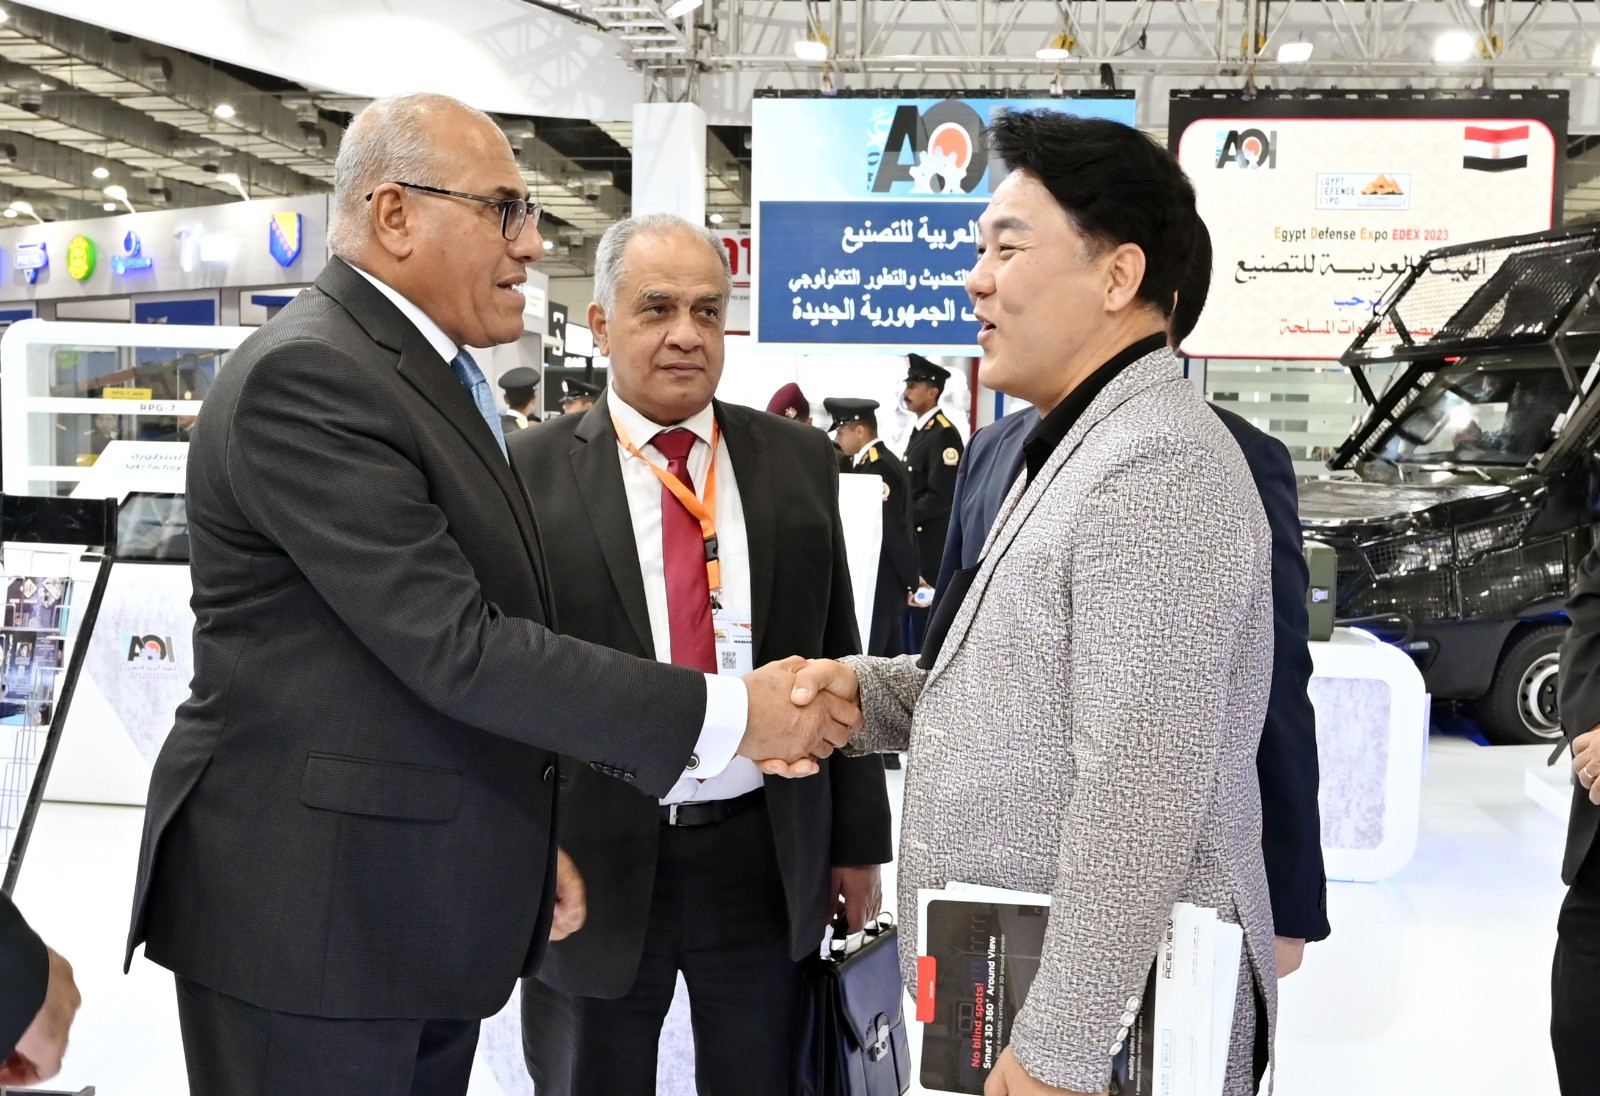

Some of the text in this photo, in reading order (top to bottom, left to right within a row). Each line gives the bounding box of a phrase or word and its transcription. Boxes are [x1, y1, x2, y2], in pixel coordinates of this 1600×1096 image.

[1320, 187, 1356, 196] DEFENCE
[842, 219, 914, 254] للتصنيع
[1274, 227, 1449, 243] Egypt Defense Expo EDEX 2023
[788, 267, 861, 292] التكنولوجي
[864, 267, 917, 291] والتطور
[1235, 253, 1315, 284] للتصنيع
[792, 296, 855, 327] الجديدة
[860, 294, 955, 328] الجمهورية
[1333, 290, 1383, 312] ترحب
[1280, 319, 1334, 335] المسلحة
[140, 404, 176, 412] RPG-7
[987, 935, 996, 959] View
[986, 960, 996, 996] Around
[970, 983, 985, 1068] No blind spots!
[985, 1023, 993, 1038] 3D
[982, 1039, 993, 1069] Smart
[1128, 1055, 1136, 1081] mobility
